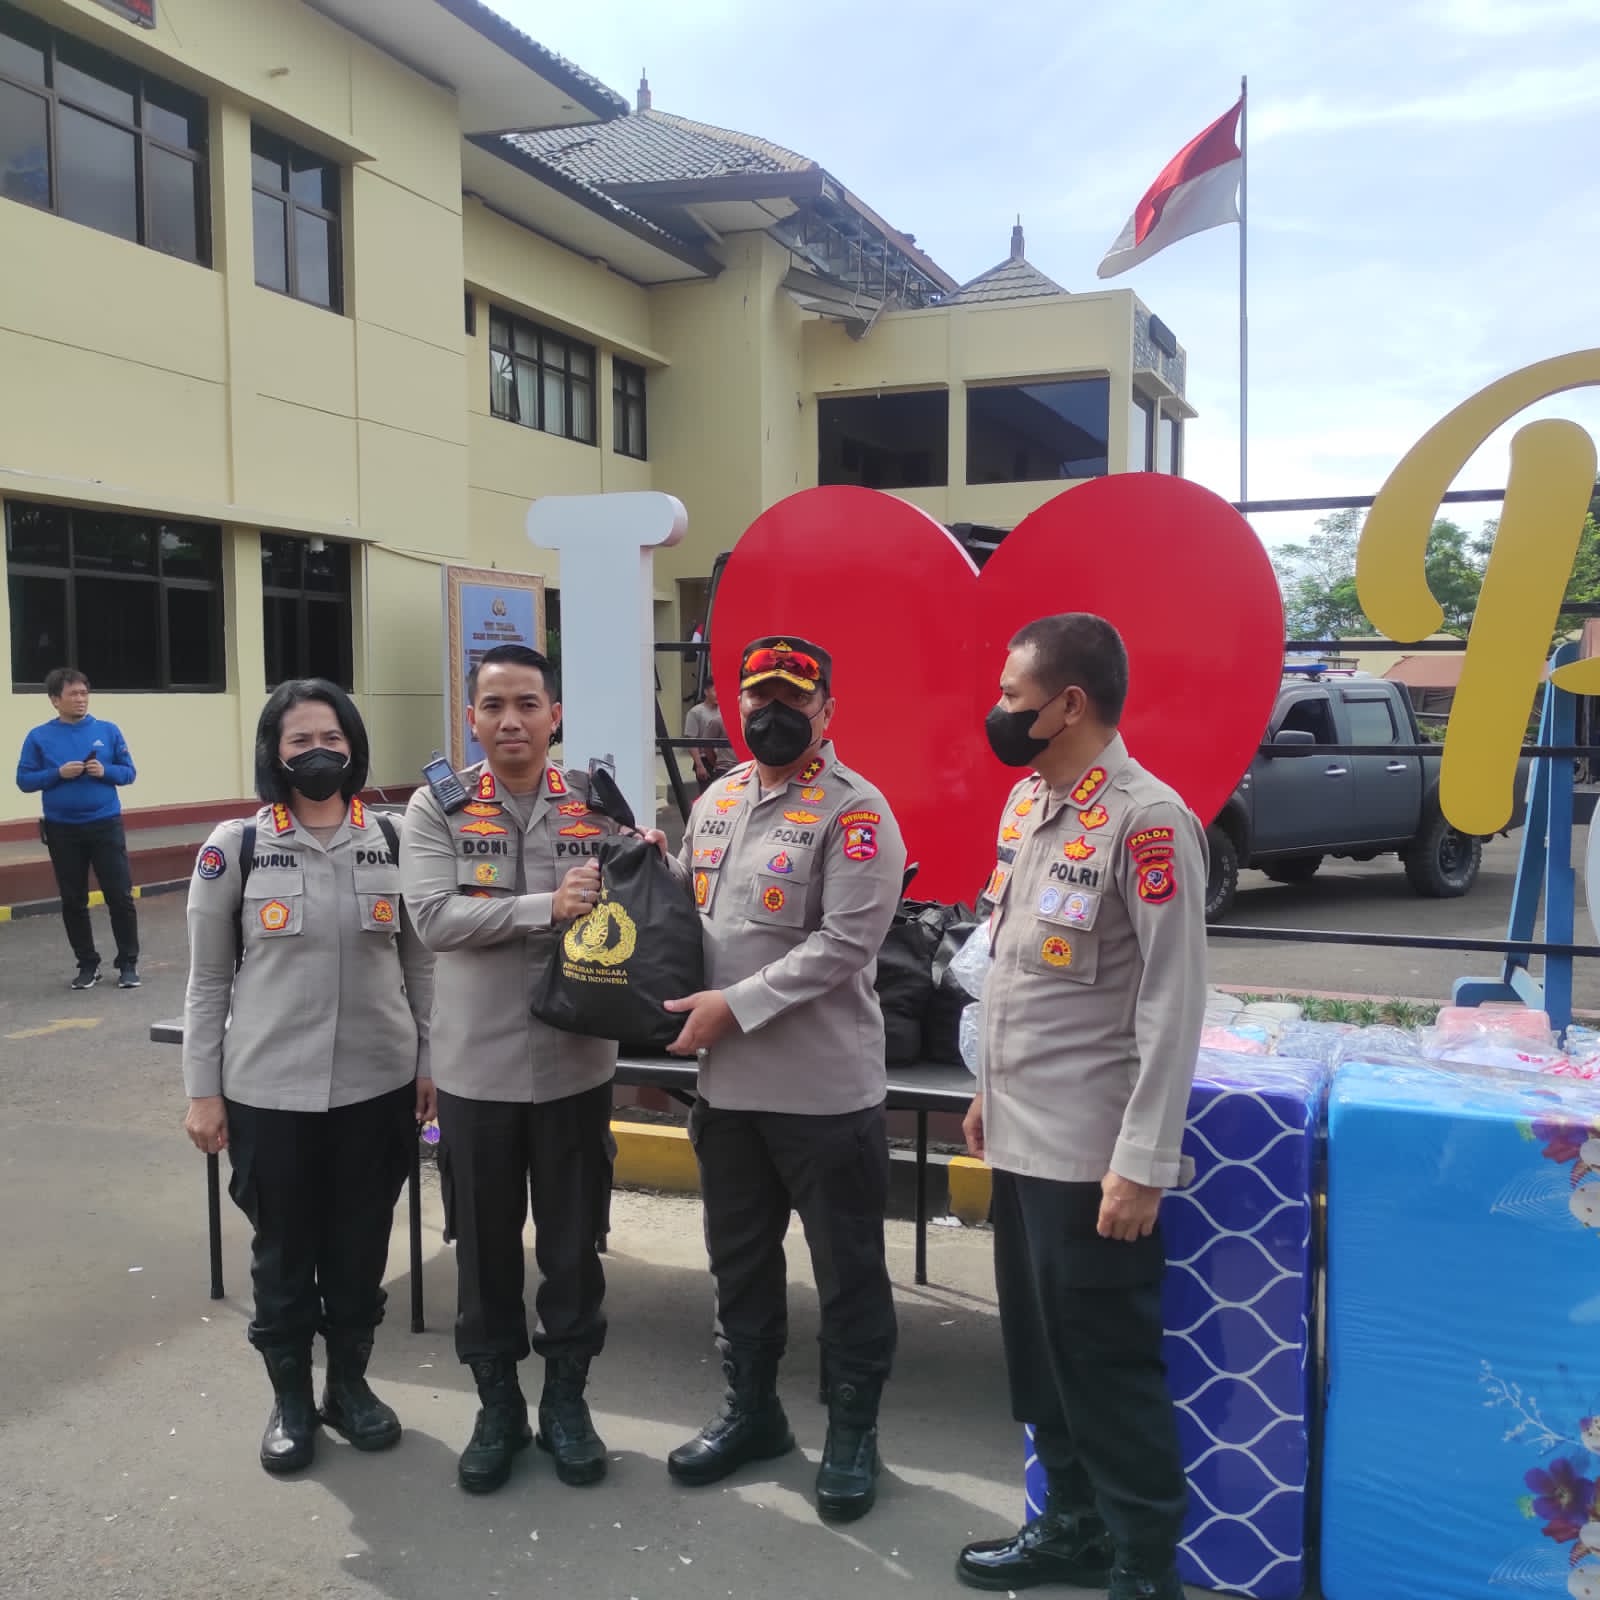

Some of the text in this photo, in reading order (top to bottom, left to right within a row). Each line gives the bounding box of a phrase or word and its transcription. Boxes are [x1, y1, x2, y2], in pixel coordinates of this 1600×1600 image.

[700, 820, 732, 835] DEDI
[774, 828, 815, 846] POLRI
[1131, 830, 1169, 846] POLDA
[462, 840, 508, 856] DONI
[556, 841, 601, 857] POLR
[251, 855, 298, 869] NURUL
[1049, 862, 1099, 887] POLRI
[588, 975, 628, 985] INDONESIA
[596, 968, 628, 977] NEGARA
